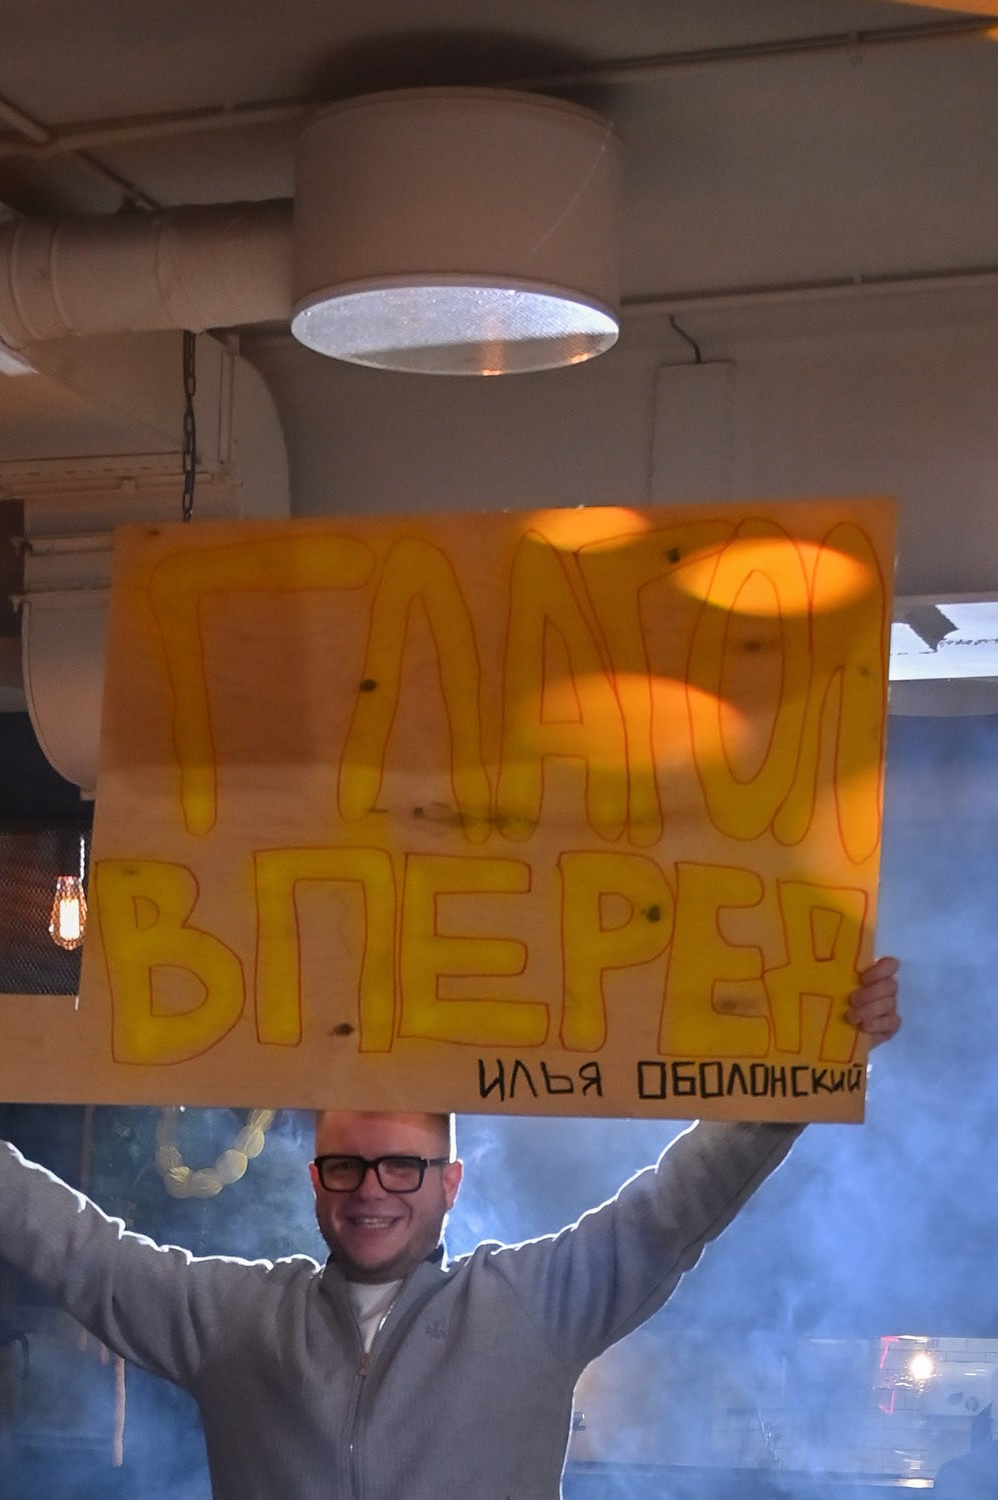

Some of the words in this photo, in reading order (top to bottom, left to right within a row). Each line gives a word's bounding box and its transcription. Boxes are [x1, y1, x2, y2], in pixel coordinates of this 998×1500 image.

[149, 516, 888, 864] ГЛАГОЛ
[94, 846, 868, 1065] ВПЕРЕД
[477, 1058, 604, 1102] ИЛЬЯ
